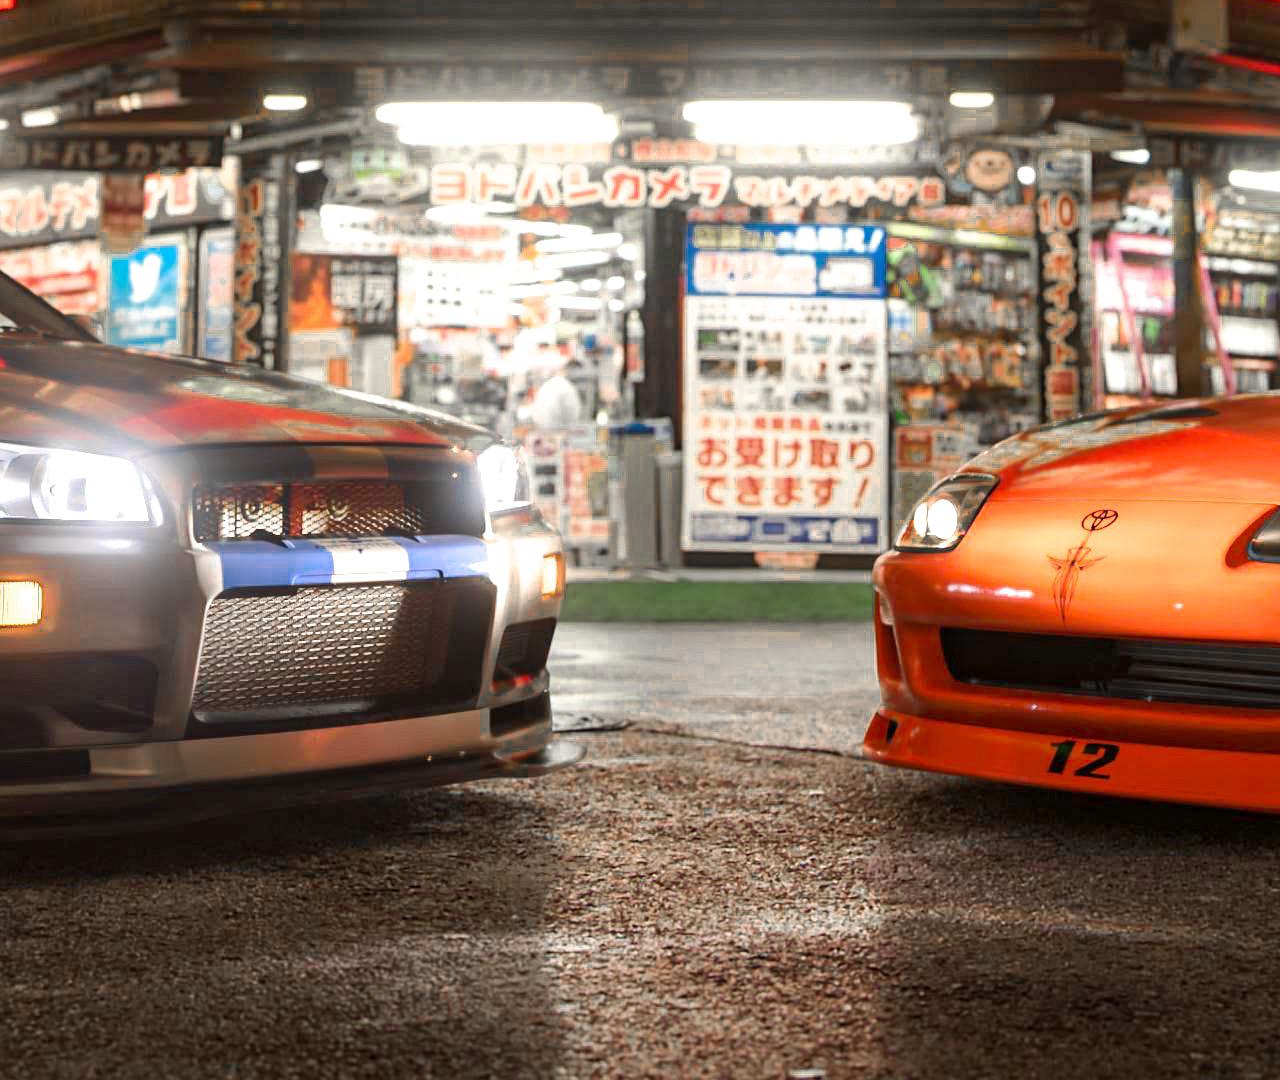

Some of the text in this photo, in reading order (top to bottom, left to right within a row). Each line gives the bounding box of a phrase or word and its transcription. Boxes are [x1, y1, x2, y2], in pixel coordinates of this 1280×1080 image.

[428, 162, 732, 209] ヨドバシカメラ
[696, 436, 875, 472] お受け取り
[696, 475, 870, 512] できます!
[1045, 739, 1120, 780] 12
